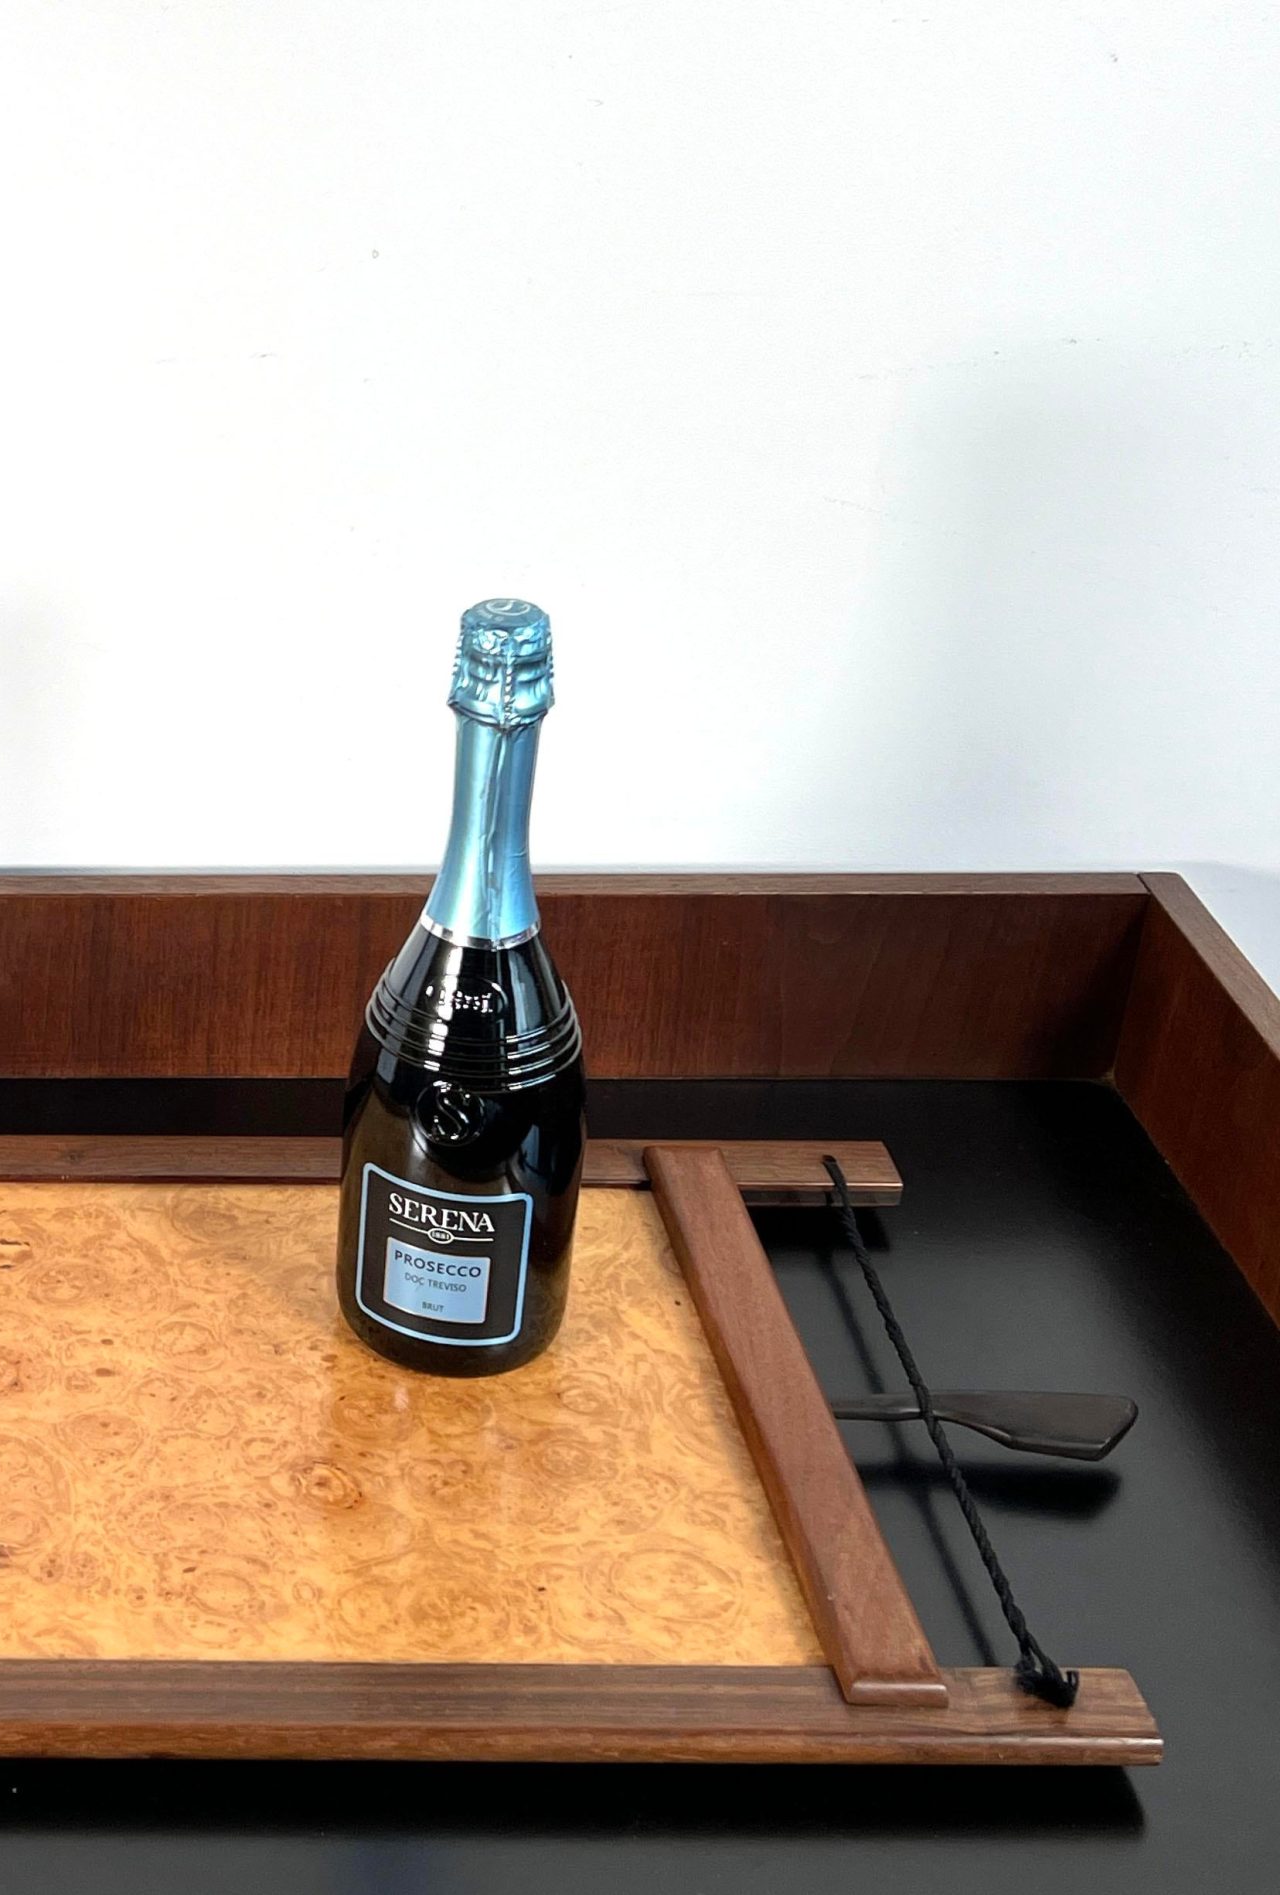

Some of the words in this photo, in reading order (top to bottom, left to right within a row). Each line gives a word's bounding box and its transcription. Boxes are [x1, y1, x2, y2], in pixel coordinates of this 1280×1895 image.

[389, 1192, 495, 1232] SERENA
[394, 1250, 482, 1278] PROSECCO
[404, 1272, 425, 1286] DOC
[428, 1279, 467, 1293] TREVISO
[422, 1302, 445, 1312] BRUT
